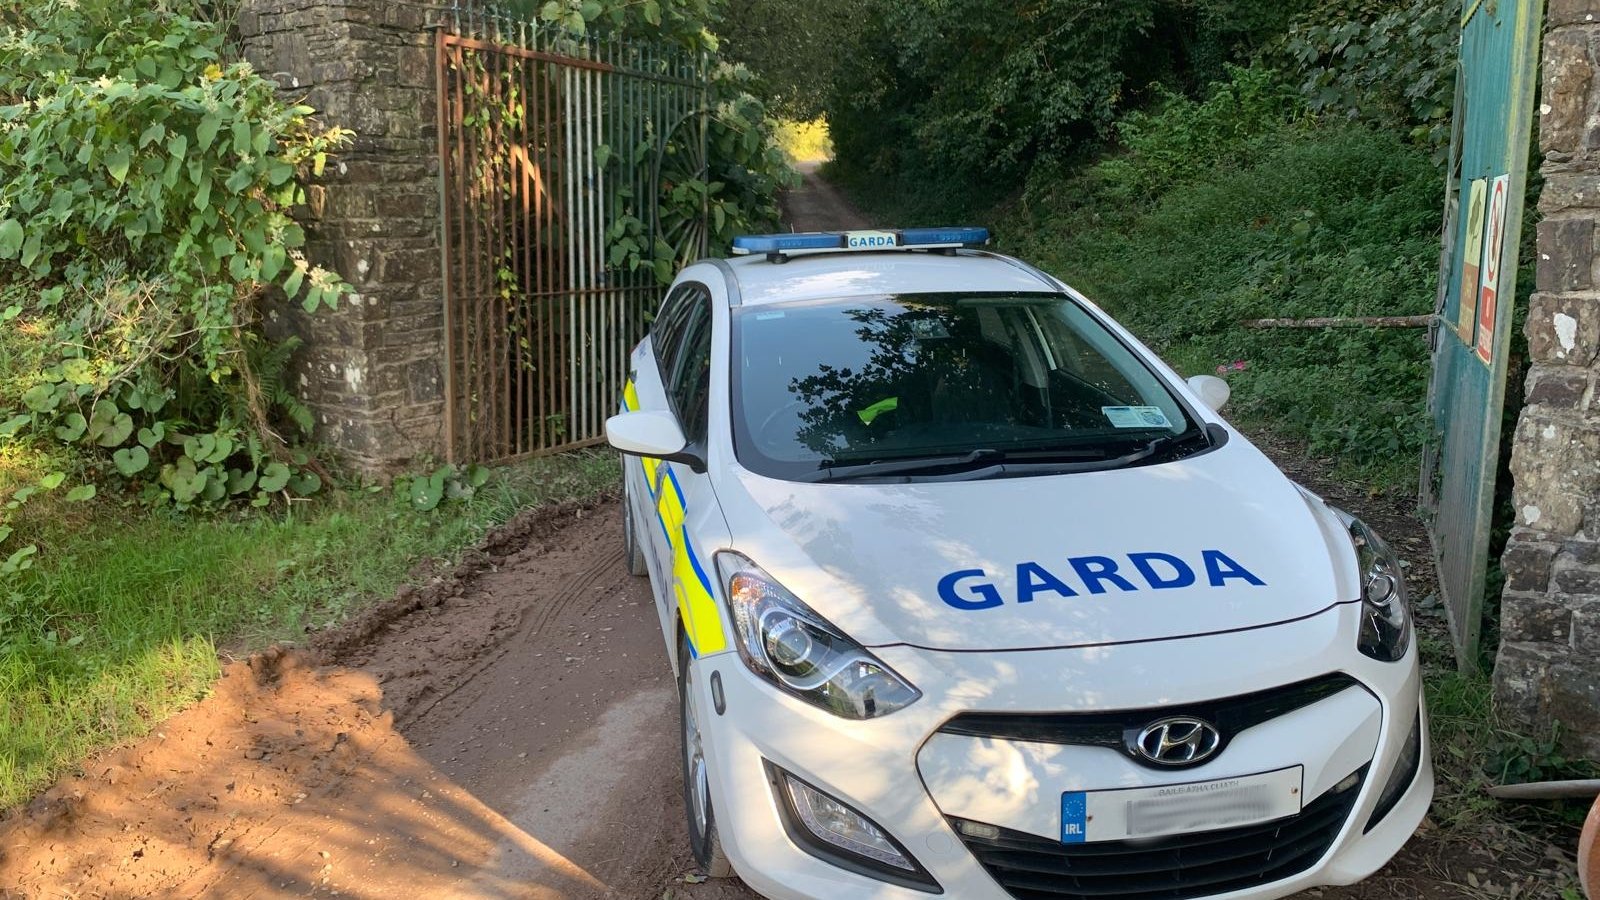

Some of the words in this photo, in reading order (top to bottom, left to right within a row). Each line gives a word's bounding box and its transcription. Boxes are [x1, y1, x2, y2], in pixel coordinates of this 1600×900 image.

[850, 236, 894, 247] GARDA
[937, 549, 1268, 611] GARDA
[1065, 823, 1083, 835] IRL
